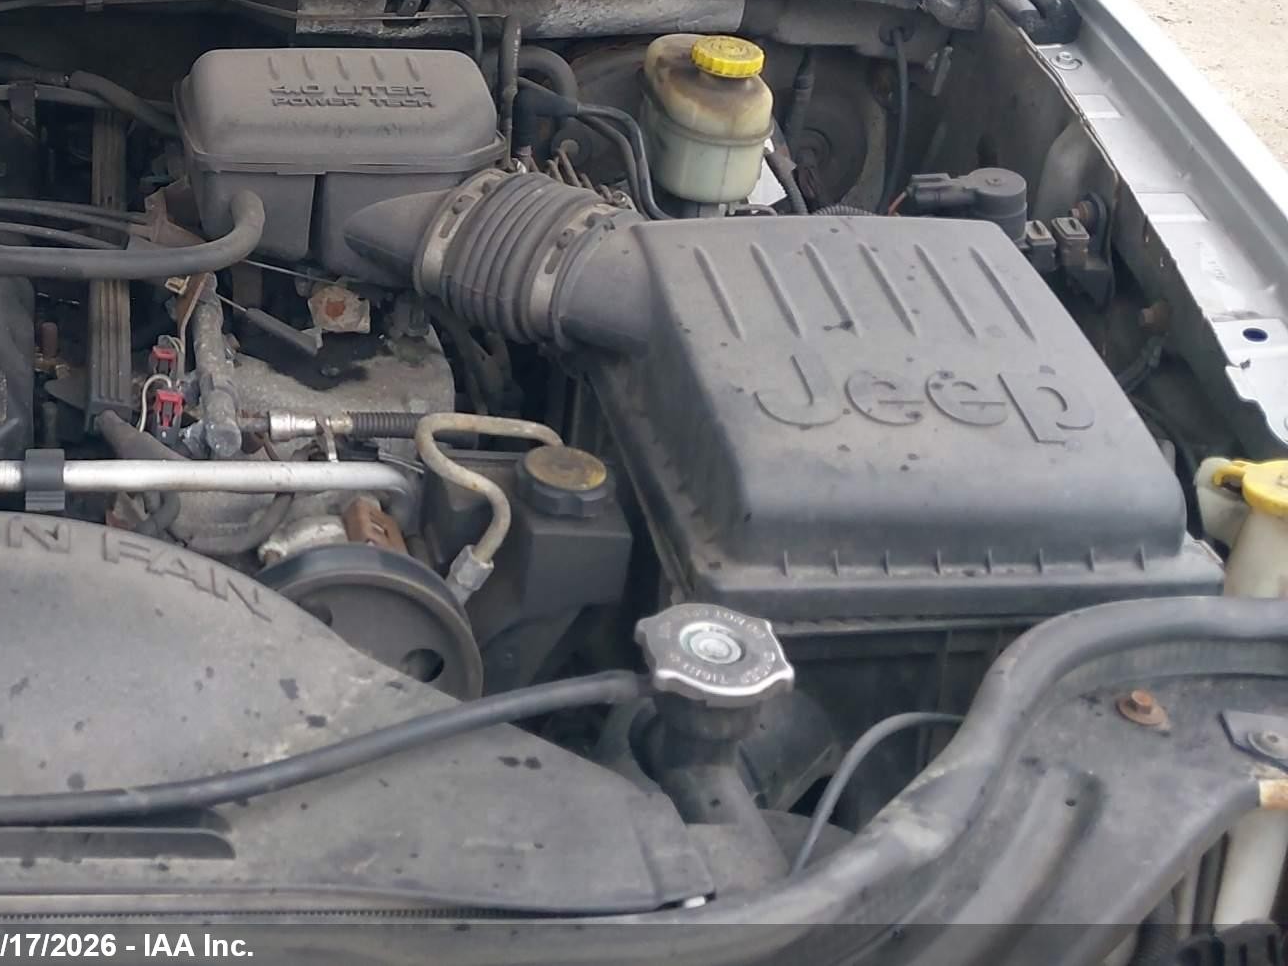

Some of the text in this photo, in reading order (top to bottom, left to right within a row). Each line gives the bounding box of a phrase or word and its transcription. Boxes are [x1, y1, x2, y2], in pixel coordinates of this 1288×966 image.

[269, 84, 432, 97] 4.0 LITER
[271, 97, 436, 109] POWER TECH
[752, 353, 1095, 445] Jeep
[103, 530, 273, 622] FAN
